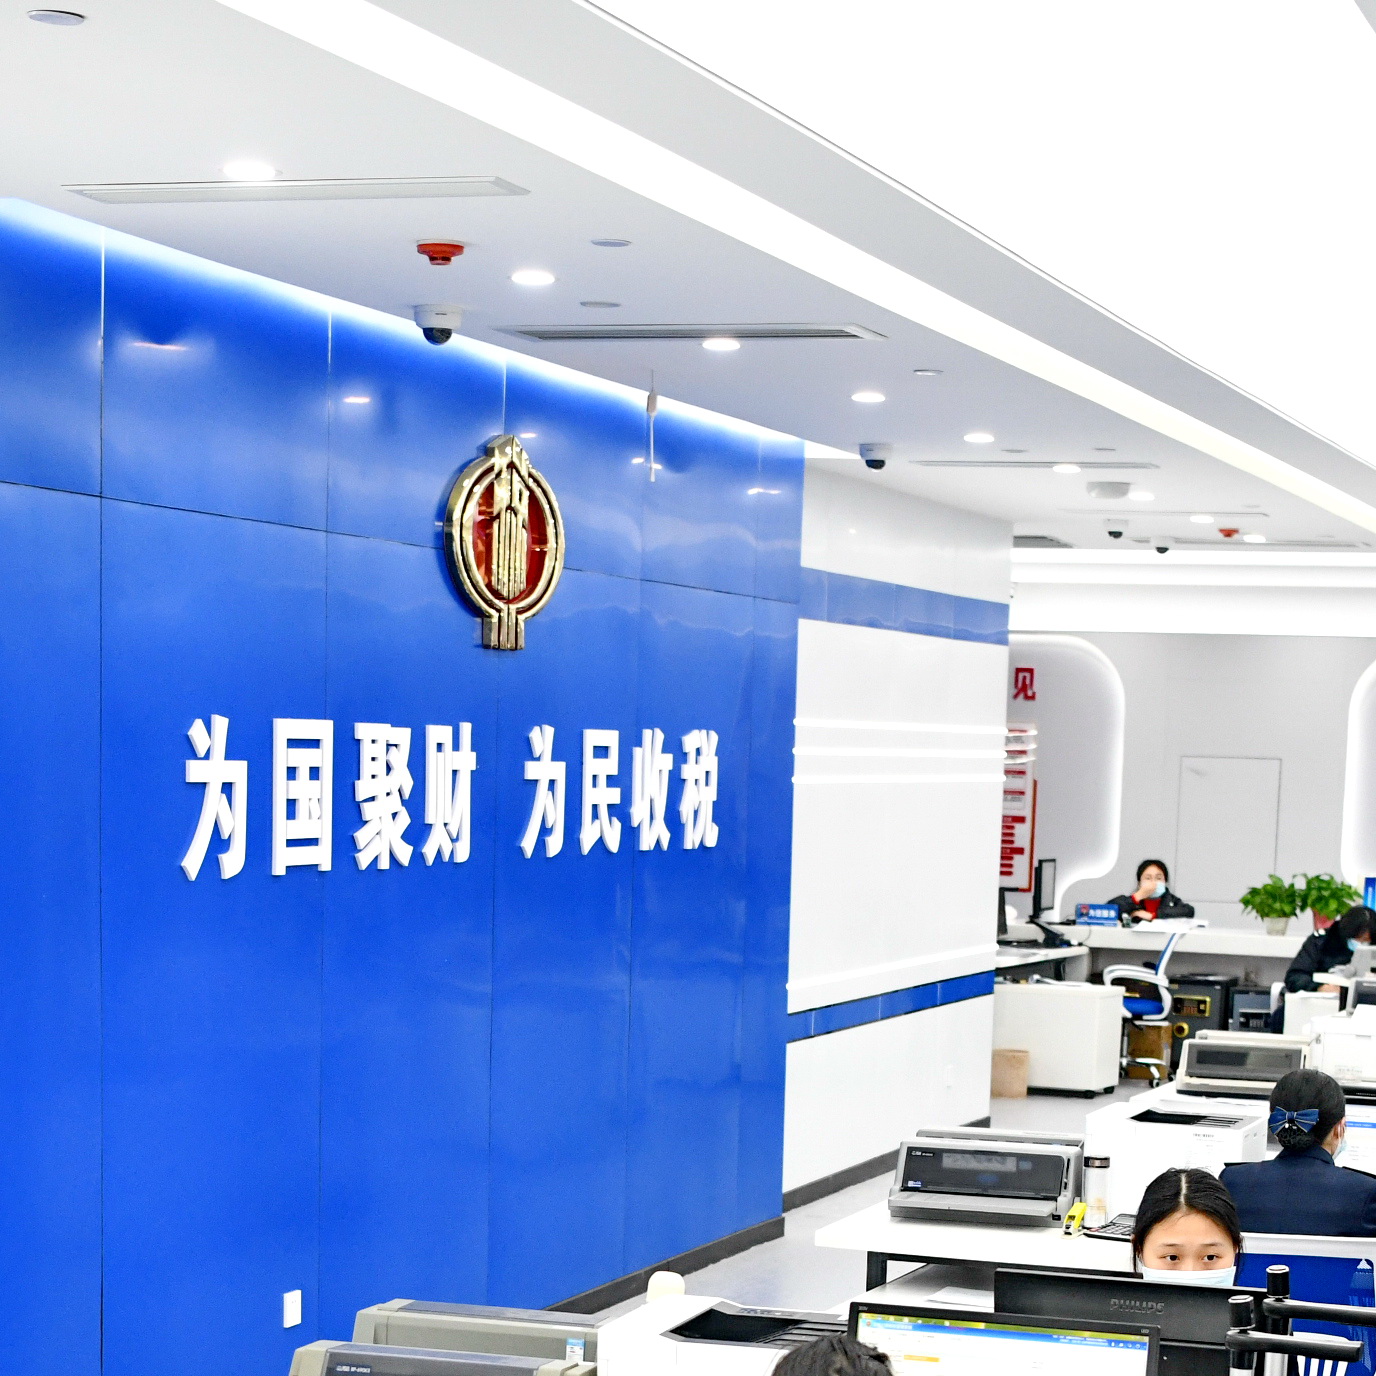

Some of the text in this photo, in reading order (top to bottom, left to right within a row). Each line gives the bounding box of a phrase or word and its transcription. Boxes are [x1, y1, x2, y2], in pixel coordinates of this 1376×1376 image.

[180, 714, 720, 881] 为国聚财 为民收税
[1110, 1299, 1165, 1314] PHILIPS
